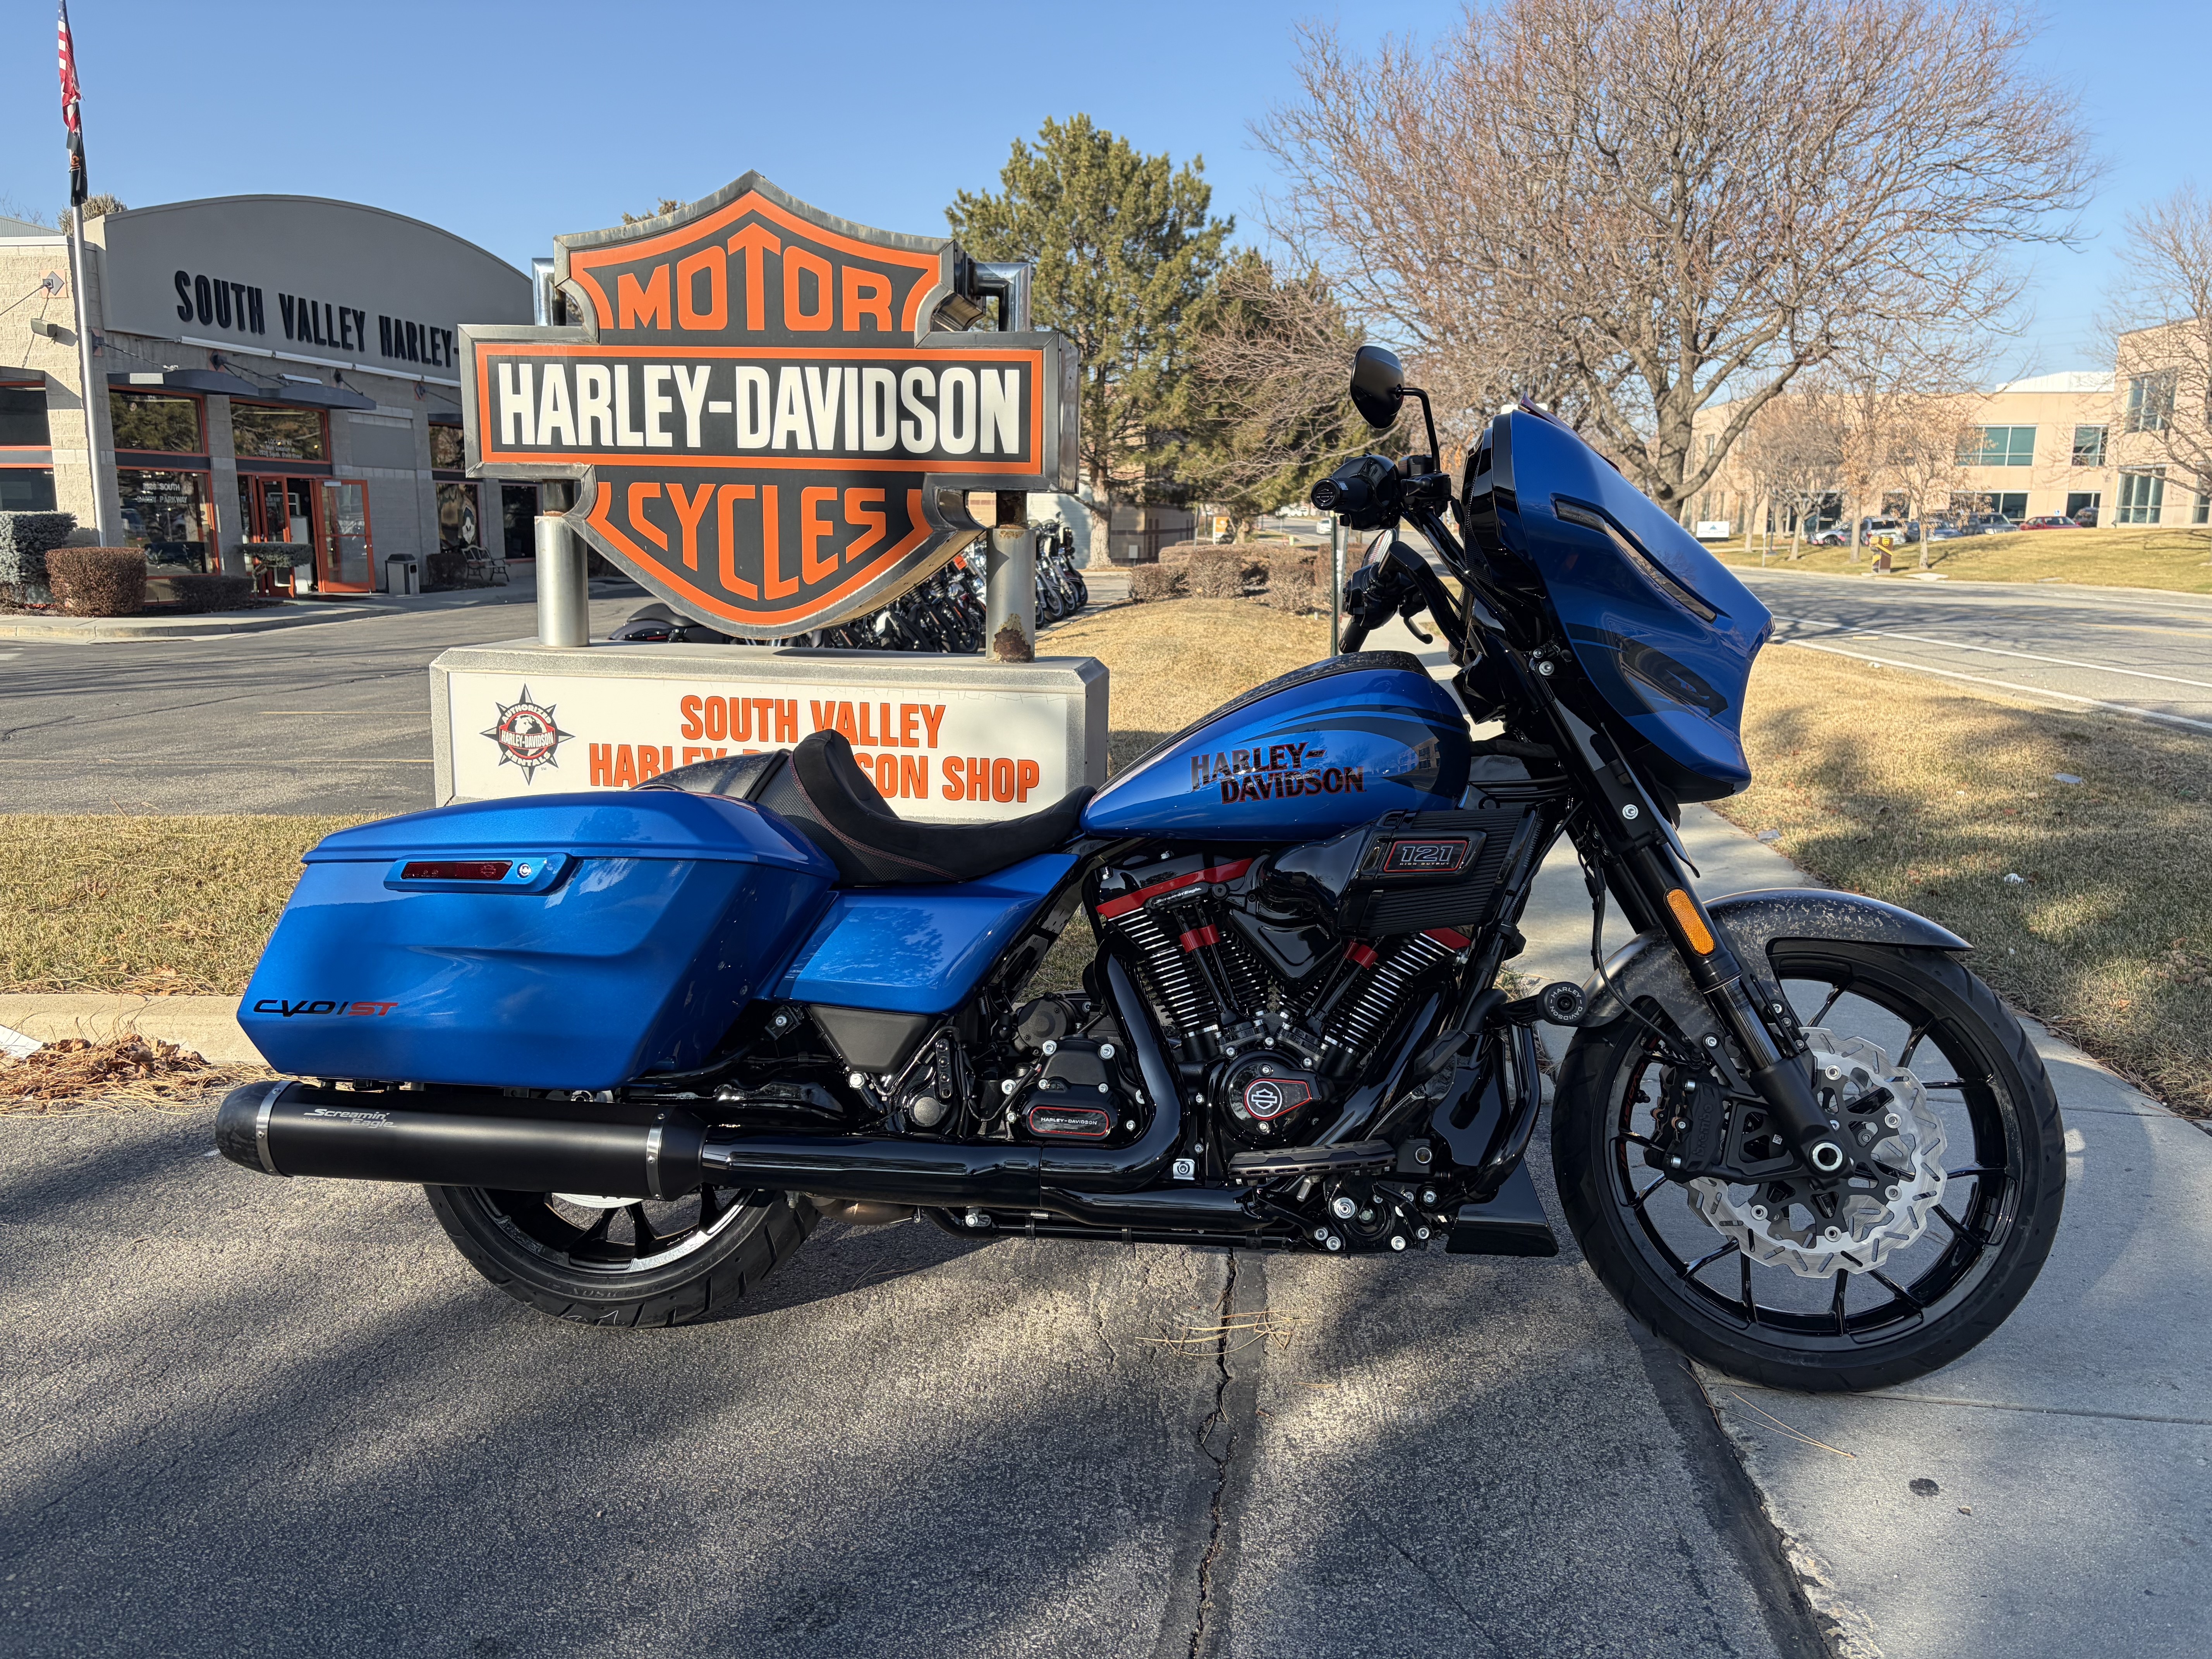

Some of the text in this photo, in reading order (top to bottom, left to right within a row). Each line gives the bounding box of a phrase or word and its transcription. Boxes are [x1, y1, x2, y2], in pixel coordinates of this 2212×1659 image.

[617, 222, 892, 331] MOTOR
[175, 270, 265, 335] SOUTH
[278, 293, 366, 352] VALLEY
[498, 363, 1020, 454] HARLEY-DAVIDSON
[160, 483, 180, 491] SOUTH
[628, 482, 886, 601] CYCLES
[501, 704, 552, 724] AUTHORIZED
[681, 695, 946, 748] SOUTH VALLEY
[501, 730, 554, 748] HARLEY-DAVIDSON
[505, 749, 551, 766] RENTALS
[942, 756, 1039, 803] SHOP
[1221, 766, 1365, 804] DAVIDSON
[1401, 846, 1453, 862] 121
[1551, 987, 1582, 998] HARLEY
[1549, 1006, 1583, 1021] DAVIDSON
[303, 1108, 390, 1120] Screamin'
[350, 1118, 397, 1129] Eagle
[1041, 1117, 1097, 1125] HARLEY-DAVIDSON
[1692, 1103, 1713, 1157] brembo
